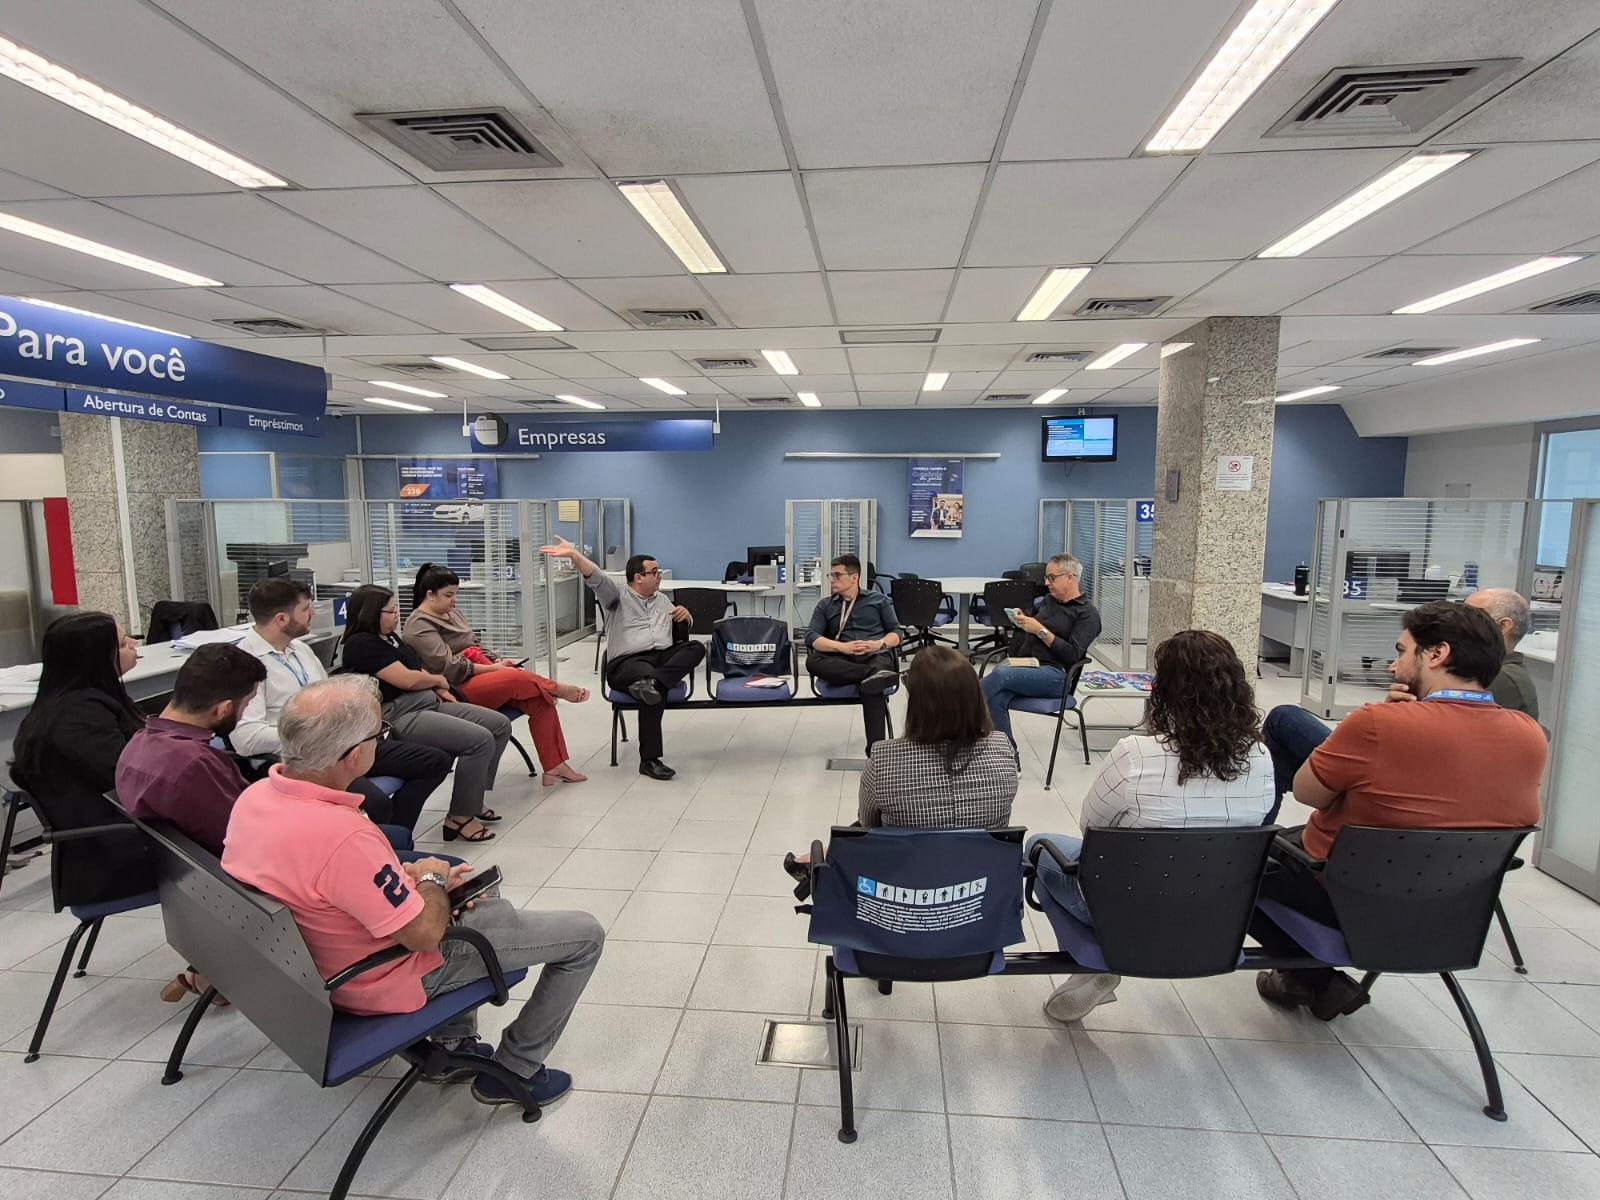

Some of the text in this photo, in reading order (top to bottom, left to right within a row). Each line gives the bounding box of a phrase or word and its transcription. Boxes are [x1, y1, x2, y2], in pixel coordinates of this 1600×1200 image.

[101, 343, 186, 382] você
[83, 394, 207, 422] Abertura de Contas
[248, 414, 304, 432] Empréstimos
[518, 428, 606, 450] Empresas
[373, 863, 410, 908] 2
